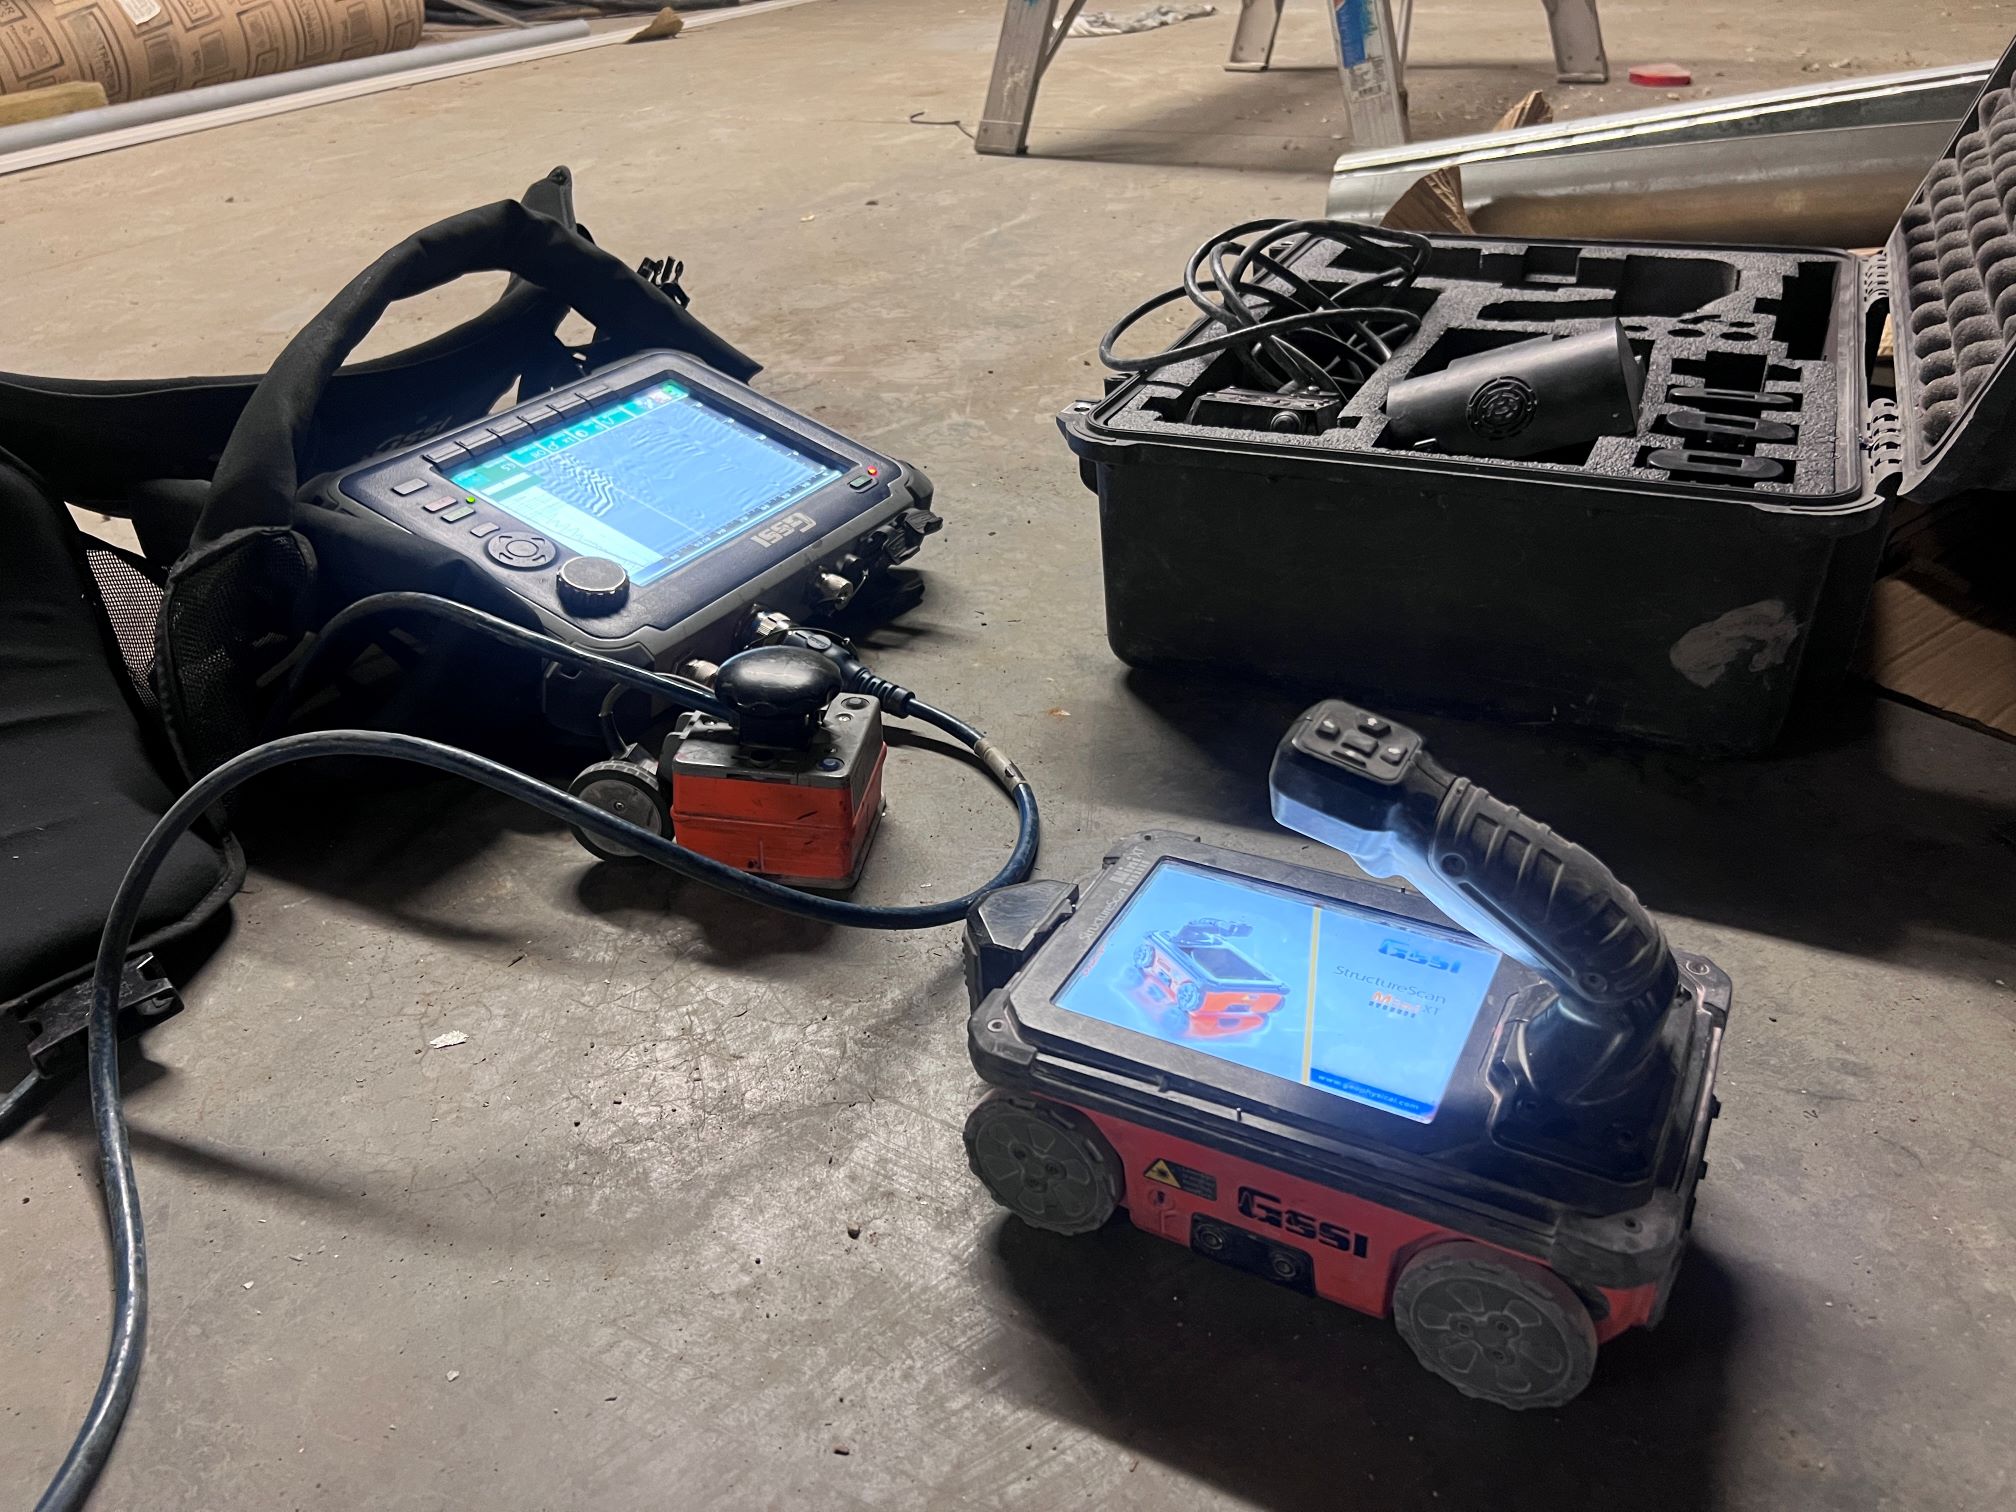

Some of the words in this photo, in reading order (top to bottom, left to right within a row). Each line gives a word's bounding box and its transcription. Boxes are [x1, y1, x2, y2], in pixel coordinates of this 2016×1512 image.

[750, 512, 817, 548] GSSI
[1108, 857, 1138, 884] Mini
[1378, 938, 1462, 974] GSSI
[1334, 965, 1446, 1004] StructureScan
[1238, 1185, 1368, 1258] GSSI
